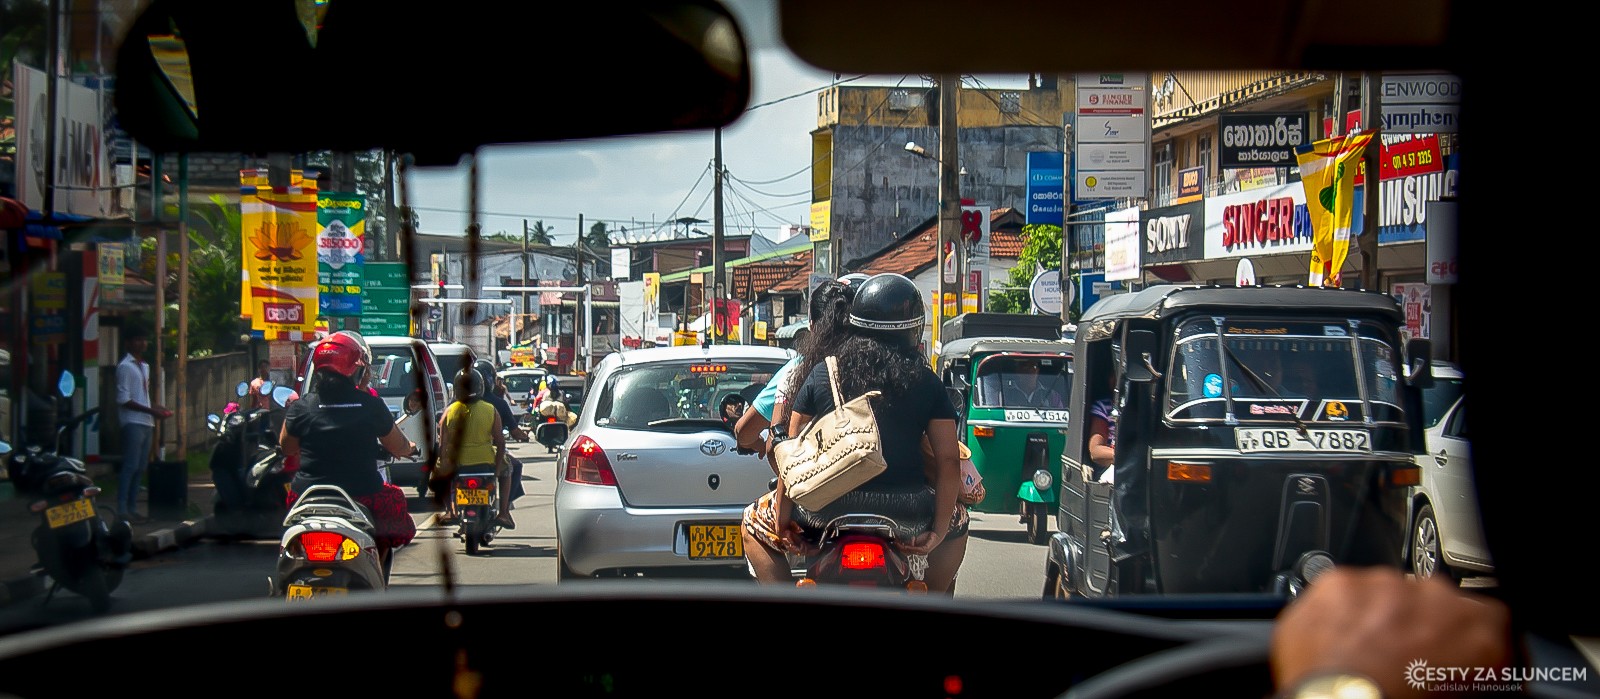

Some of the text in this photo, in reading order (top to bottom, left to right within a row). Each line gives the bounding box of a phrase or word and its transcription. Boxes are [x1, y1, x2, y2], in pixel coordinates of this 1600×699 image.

[1381, 81, 1462, 97] ENWOOD
[1380, 109, 1458, 130] ymphon
[1377, 169, 1459, 227] MSUN
[1222, 197, 1293, 247] SINGER
[1146, 214, 1192, 254] SONY
[1261, 430, 1291, 449] QB
[1314, 431, 1370, 450] 7882
[705, 526, 727, 542] KJ
[695, 541, 736, 557] 9178
